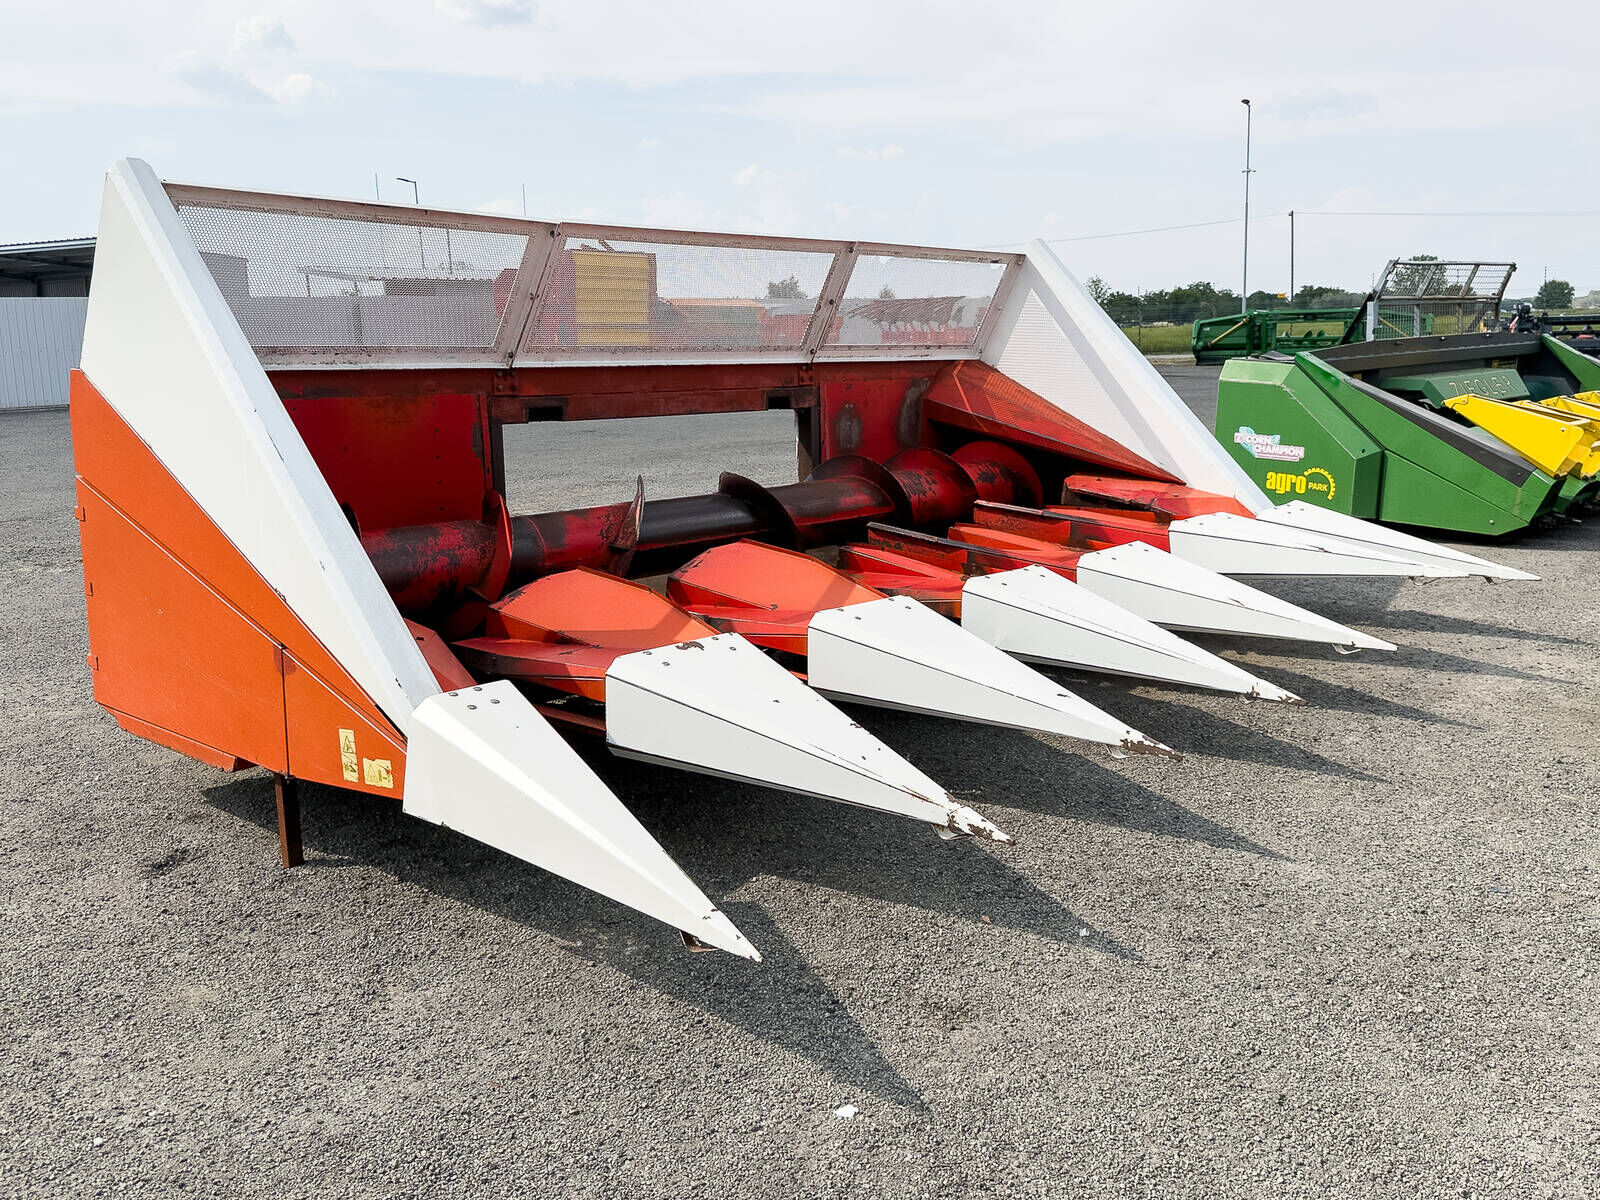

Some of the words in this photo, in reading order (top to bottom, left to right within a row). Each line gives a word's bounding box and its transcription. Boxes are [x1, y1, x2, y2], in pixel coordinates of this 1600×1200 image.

[1448, 375, 1517, 396] ZIEGLER
[1245, 435, 1273, 445] CORN
[1254, 445, 1303, 457] CHAMPION
[1266, 472, 1307, 494] agro
[1308, 482, 1328, 492] PARK
